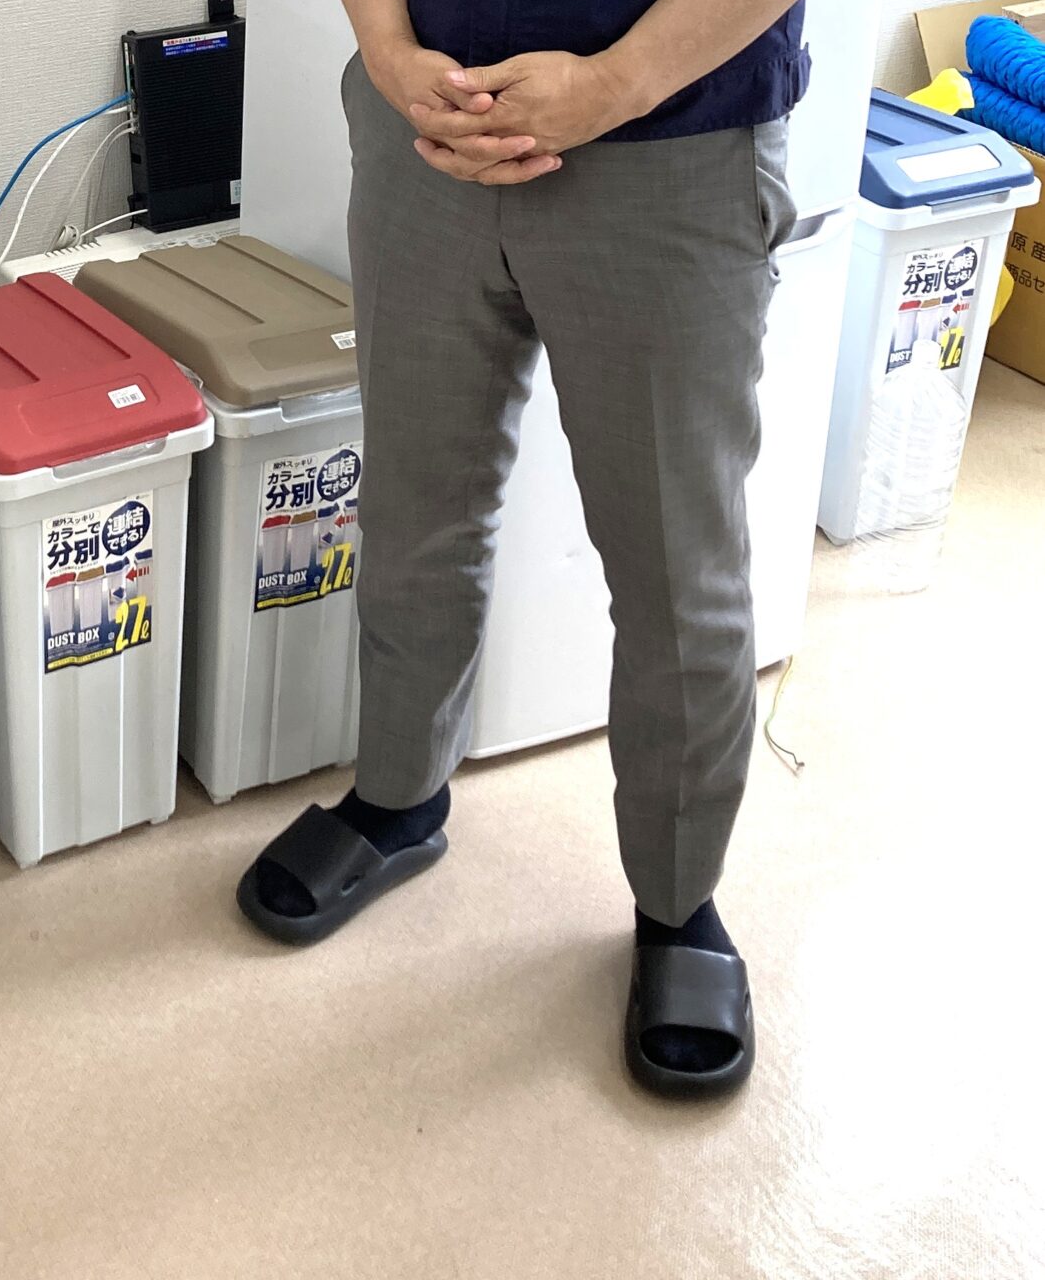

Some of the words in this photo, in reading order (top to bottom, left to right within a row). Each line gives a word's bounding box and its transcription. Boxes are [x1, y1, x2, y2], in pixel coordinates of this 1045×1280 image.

[906, 260, 946, 274] カラーで
[902, 271, 942, 295] 分別
[268, 466, 317, 485] カラーで
[266, 480, 314, 511] 分別
[48, 521, 100, 544] カラーで
[107, 507, 144, 537] 連結
[47, 535, 99, 570] 分別
[258, 574, 285, 589] DUST
[287, 570, 308, 585] BOX
[47, 632, 75, 650] DUST
[77, 627, 99, 644] BOX
